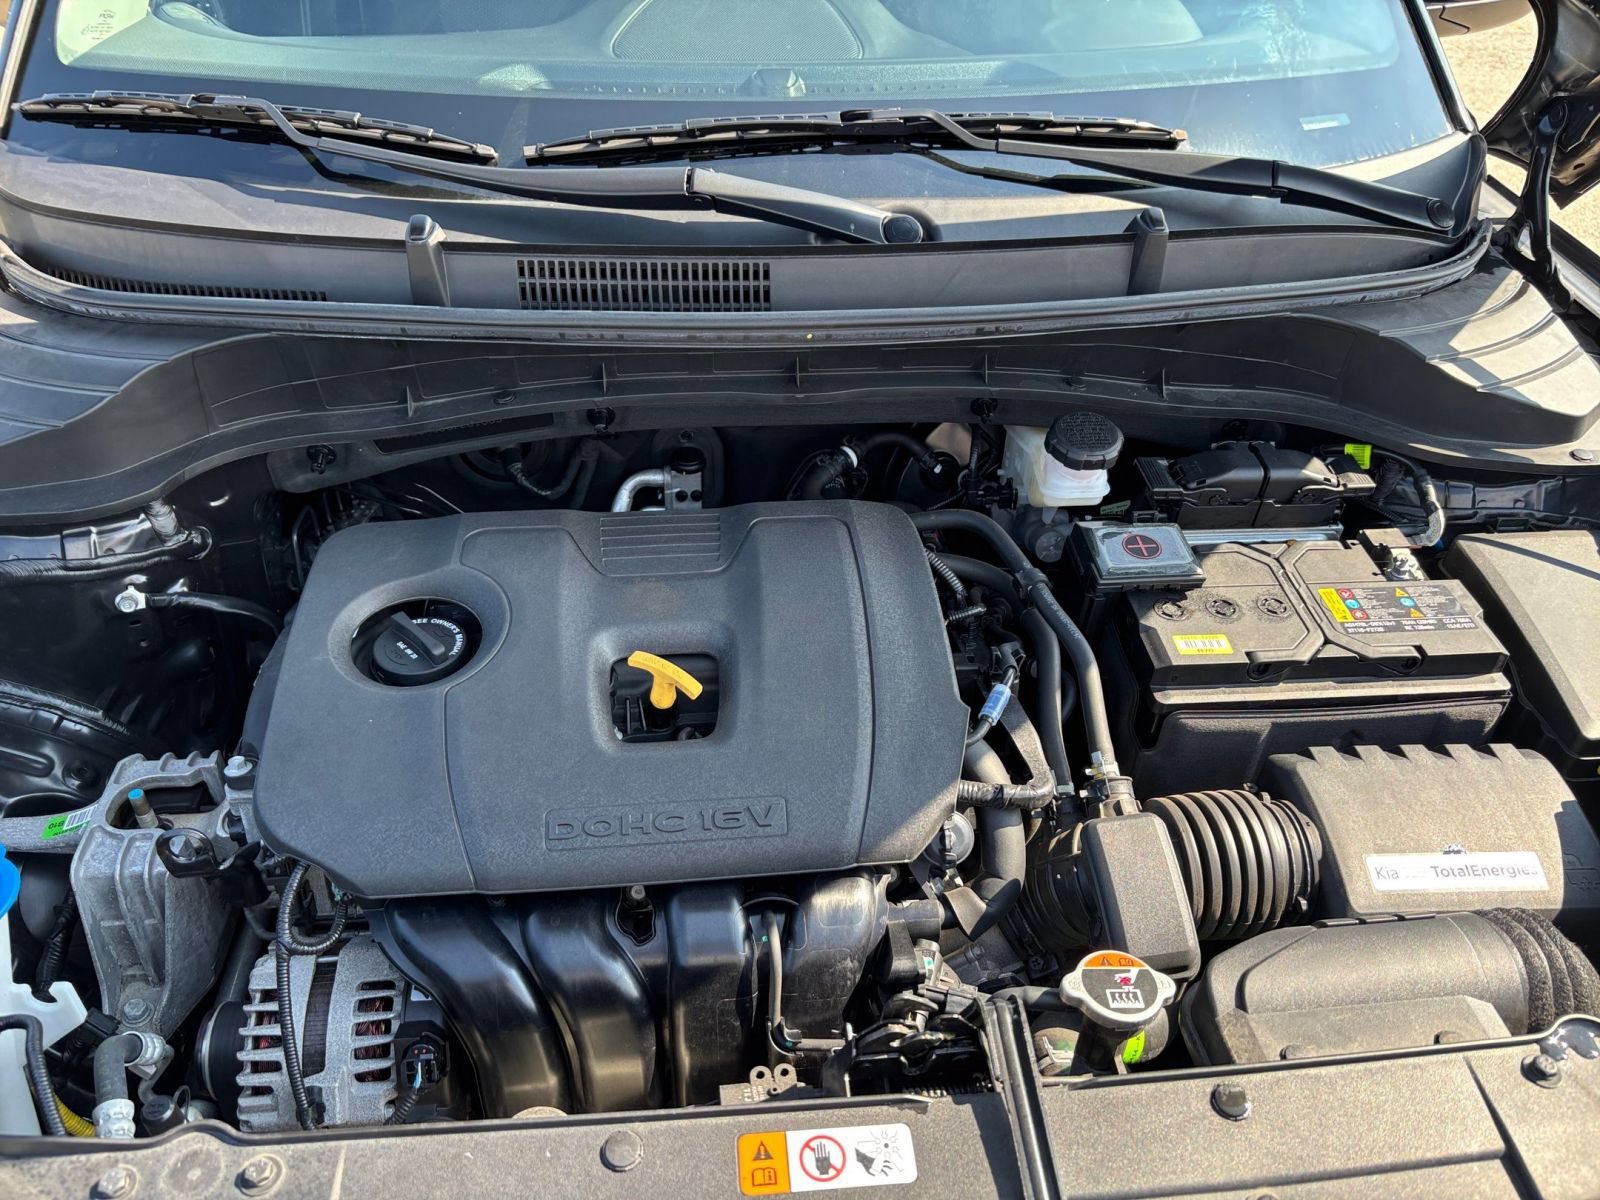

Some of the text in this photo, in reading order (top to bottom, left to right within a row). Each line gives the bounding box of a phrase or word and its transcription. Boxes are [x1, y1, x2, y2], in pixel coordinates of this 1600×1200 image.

[547, 805, 773, 840] DOHC 16V
[1374, 866, 1400, 880] Kia
